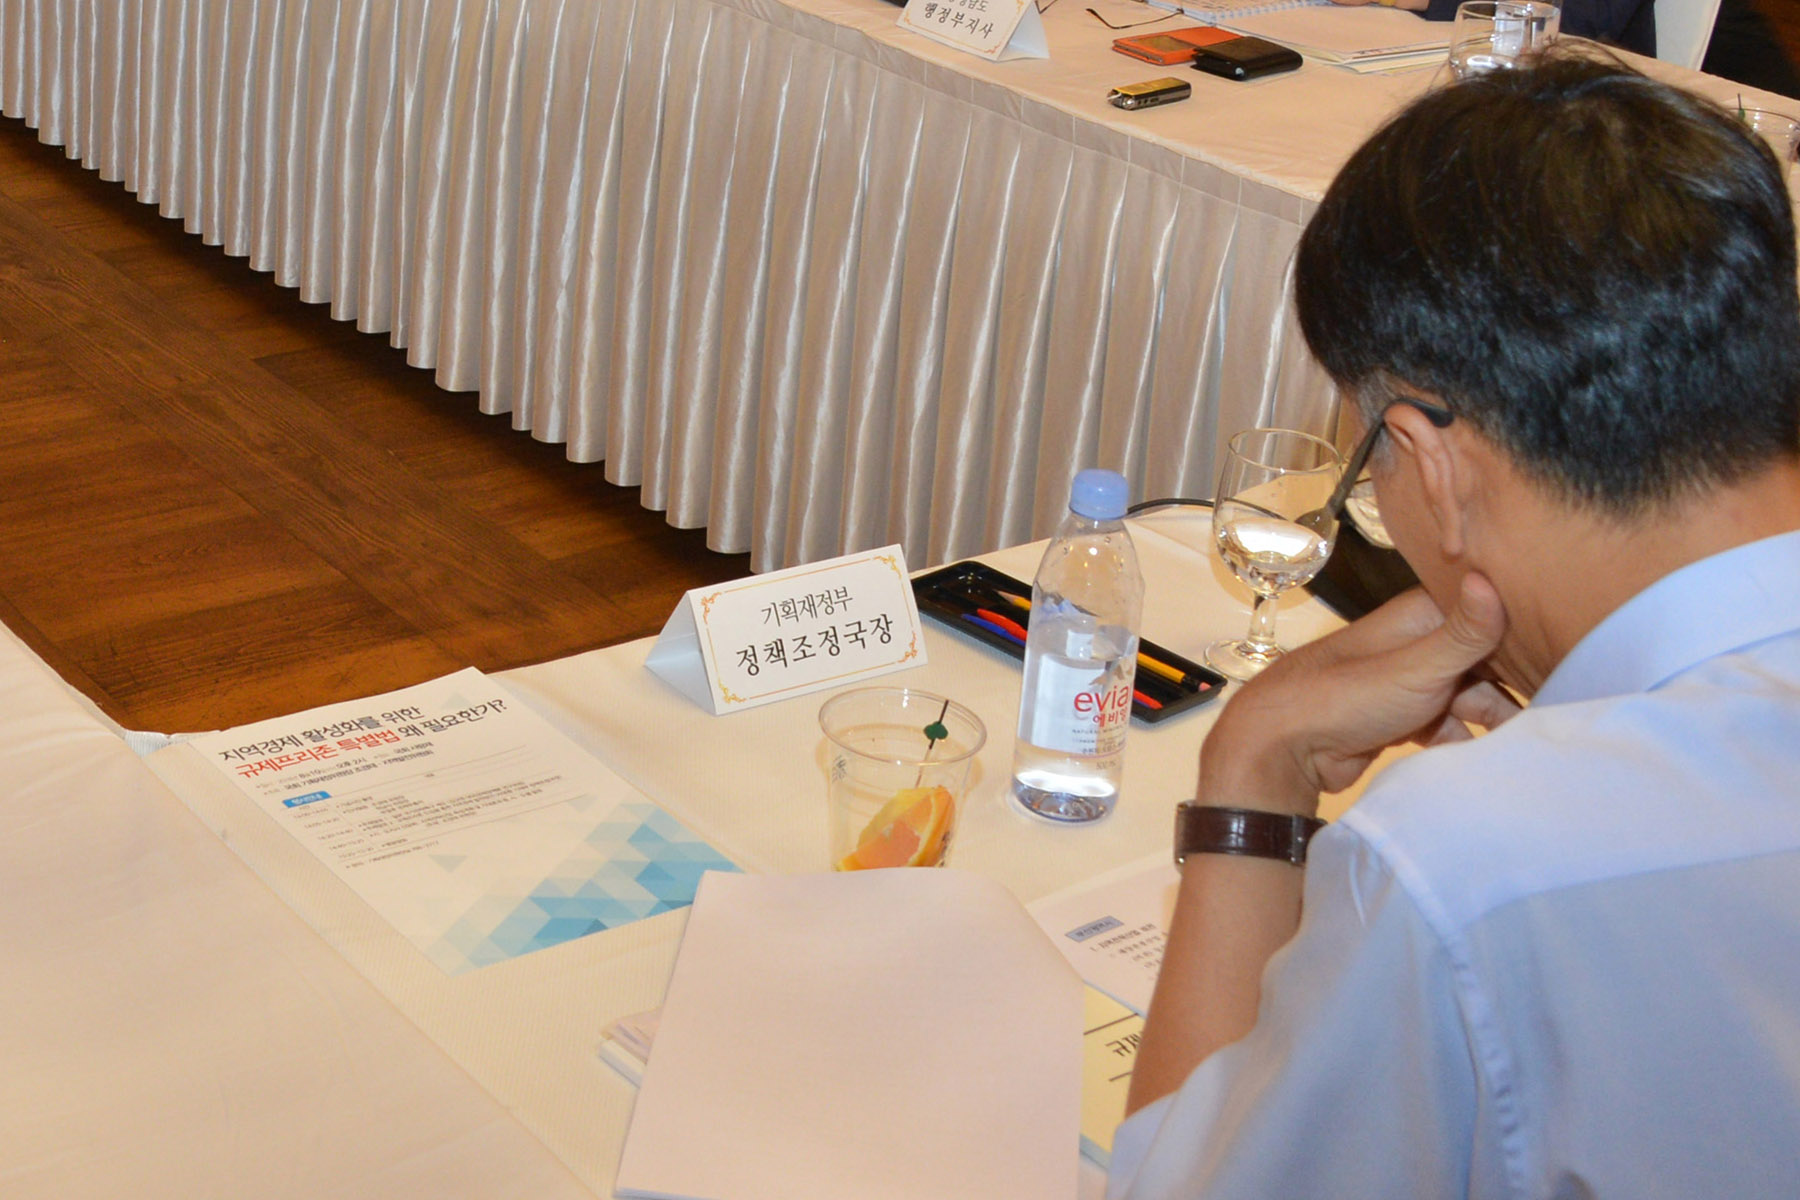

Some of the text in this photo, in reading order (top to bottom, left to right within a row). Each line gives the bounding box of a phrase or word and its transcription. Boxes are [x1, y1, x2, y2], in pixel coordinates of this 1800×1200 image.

[925, 2, 994, 39] 행정부지사
[761, 586, 853, 627] 기획재정부
[736, 613, 893, 676] 정책조정국장
[220, 705, 425, 762] 지역경제 활성화를 위한
[235, 698, 508, 779] 규제프리존 특별법 왜 필요한가?
